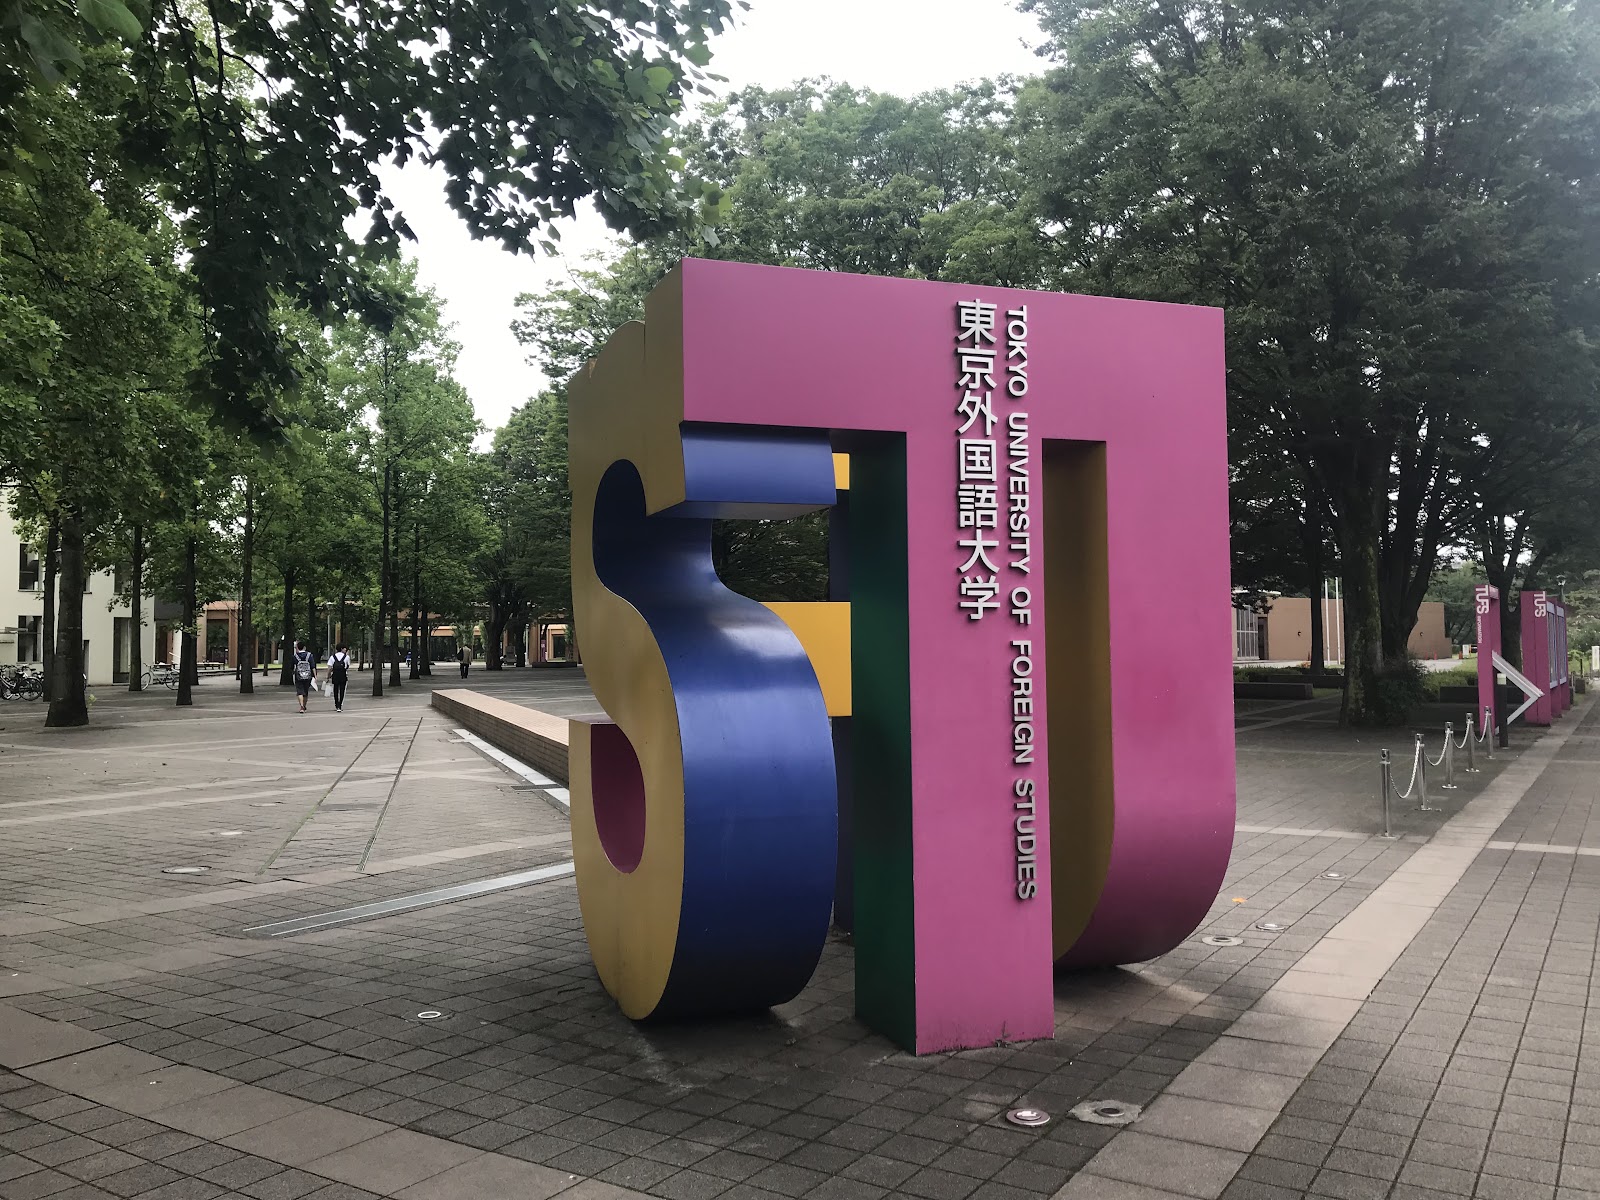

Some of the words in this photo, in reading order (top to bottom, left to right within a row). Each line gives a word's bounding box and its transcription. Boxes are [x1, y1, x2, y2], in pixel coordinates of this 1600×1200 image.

[1007, 305, 1028, 397] TOKYO
[957, 298, 1000, 620] 東京外国語大学
[1008, 412, 1031, 574] UNIVERSITY
[1011, 586, 1032, 625] OF
[1475, 585, 1489, 614] TUFS
[1533, 591, 1546, 618] TUFS
[1011, 639, 1035, 764] FOREIGN
[1015, 777, 1037, 900] STUDIES
